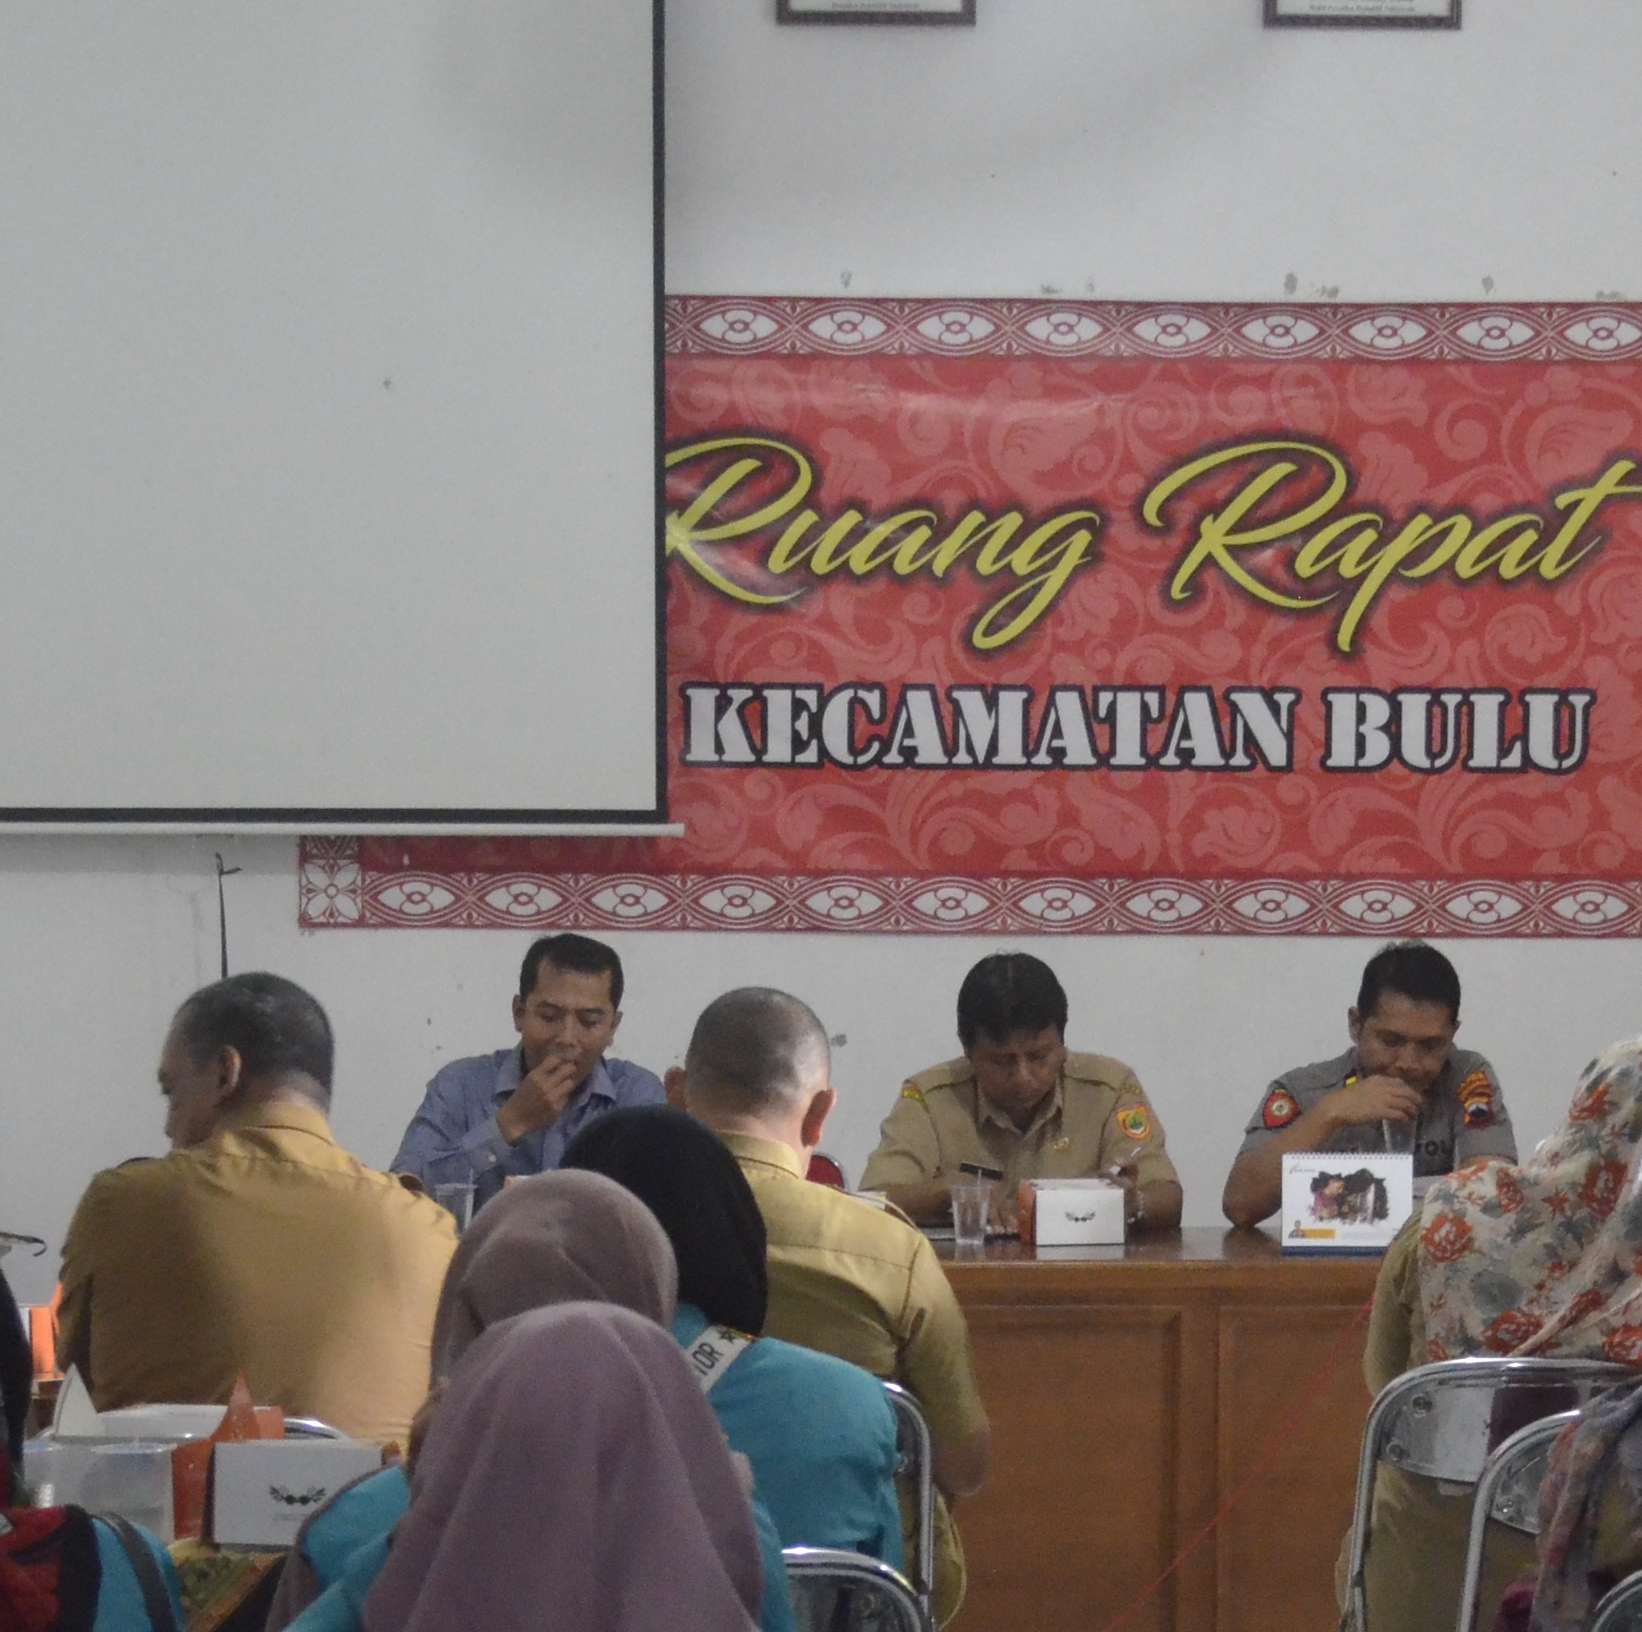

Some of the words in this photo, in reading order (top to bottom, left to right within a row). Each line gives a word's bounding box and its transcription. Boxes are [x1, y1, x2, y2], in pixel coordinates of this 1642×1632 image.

[665, 436, 1100, 650] Ruang
[682, 683, 1298, 769] KECAMATAN
[1322, 687, 1595, 772] BULU
